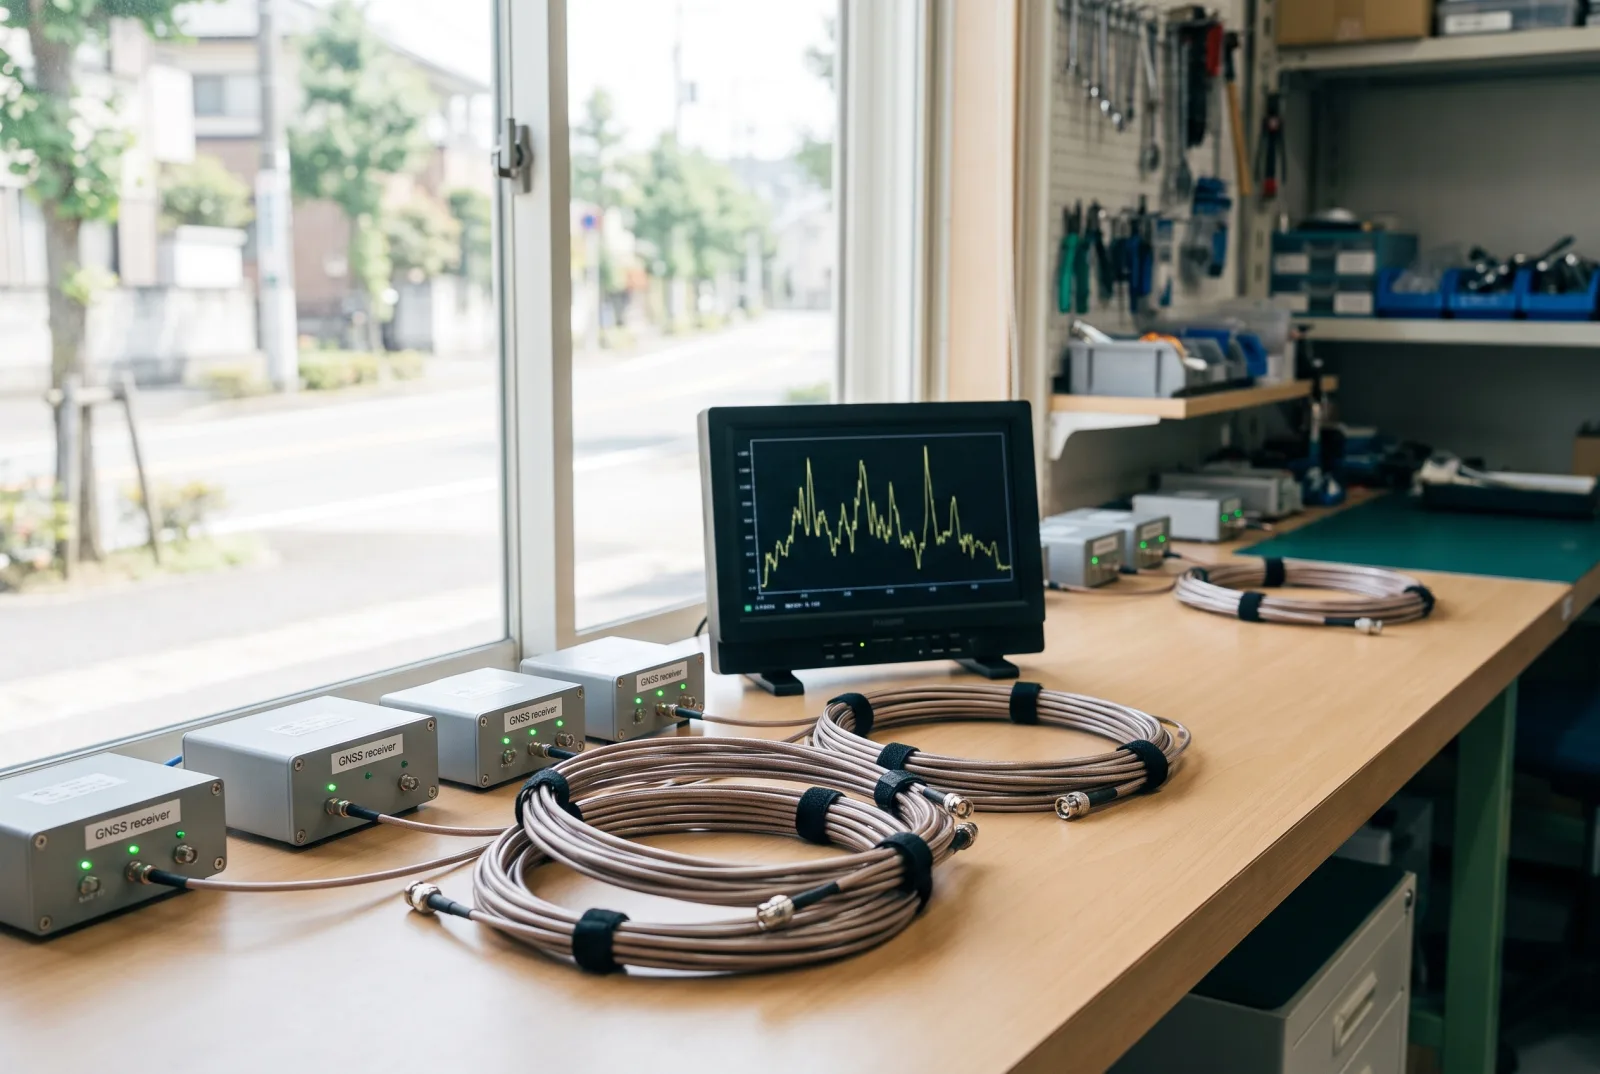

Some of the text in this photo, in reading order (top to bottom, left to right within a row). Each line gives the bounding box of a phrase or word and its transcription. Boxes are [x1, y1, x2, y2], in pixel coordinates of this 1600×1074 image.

[641, 674, 659, 687] GNSS
[509, 705, 557, 726] GNSS receiver
[338, 742, 397, 767] GNSS receiver
[95, 810, 171, 840] GNSS receiver
